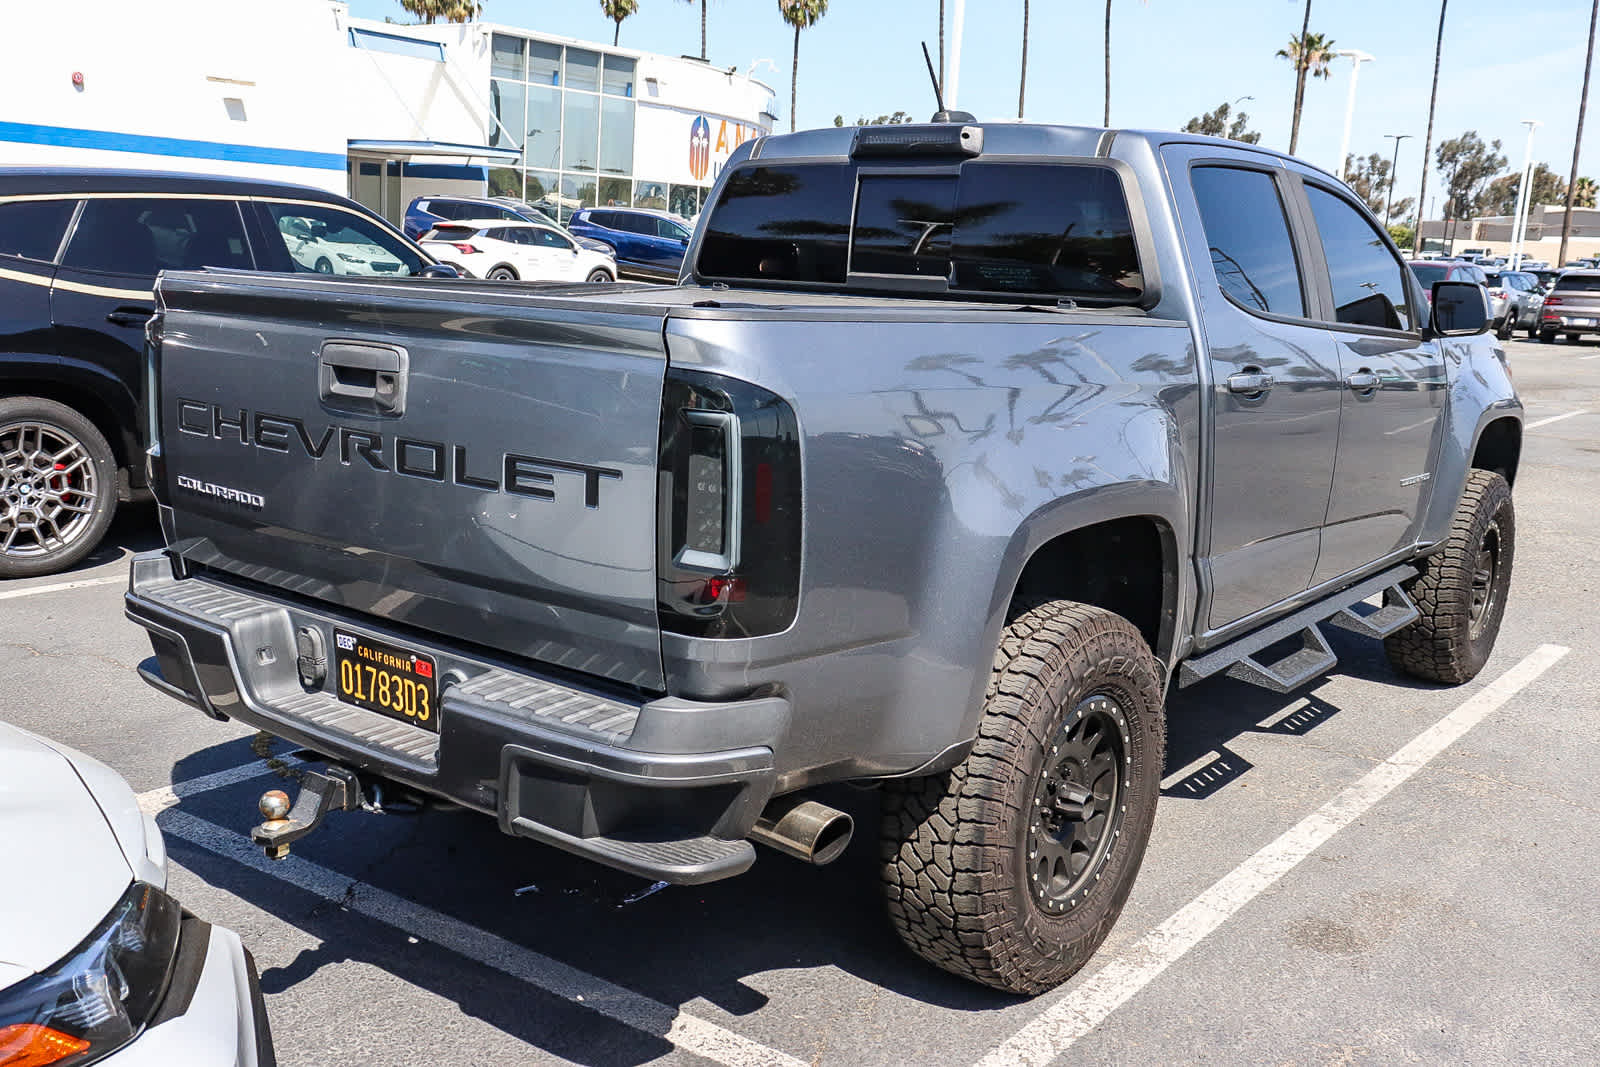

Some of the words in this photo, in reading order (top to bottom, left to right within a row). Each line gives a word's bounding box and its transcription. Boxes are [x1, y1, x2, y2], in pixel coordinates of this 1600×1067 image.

[178, 399, 624, 510] CHEVROLET
[177, 475, 265, 507] COLORADO
[357, 645, 412, 673] CALIFORNIA
[341, 659, 430, 721] 01783D3
